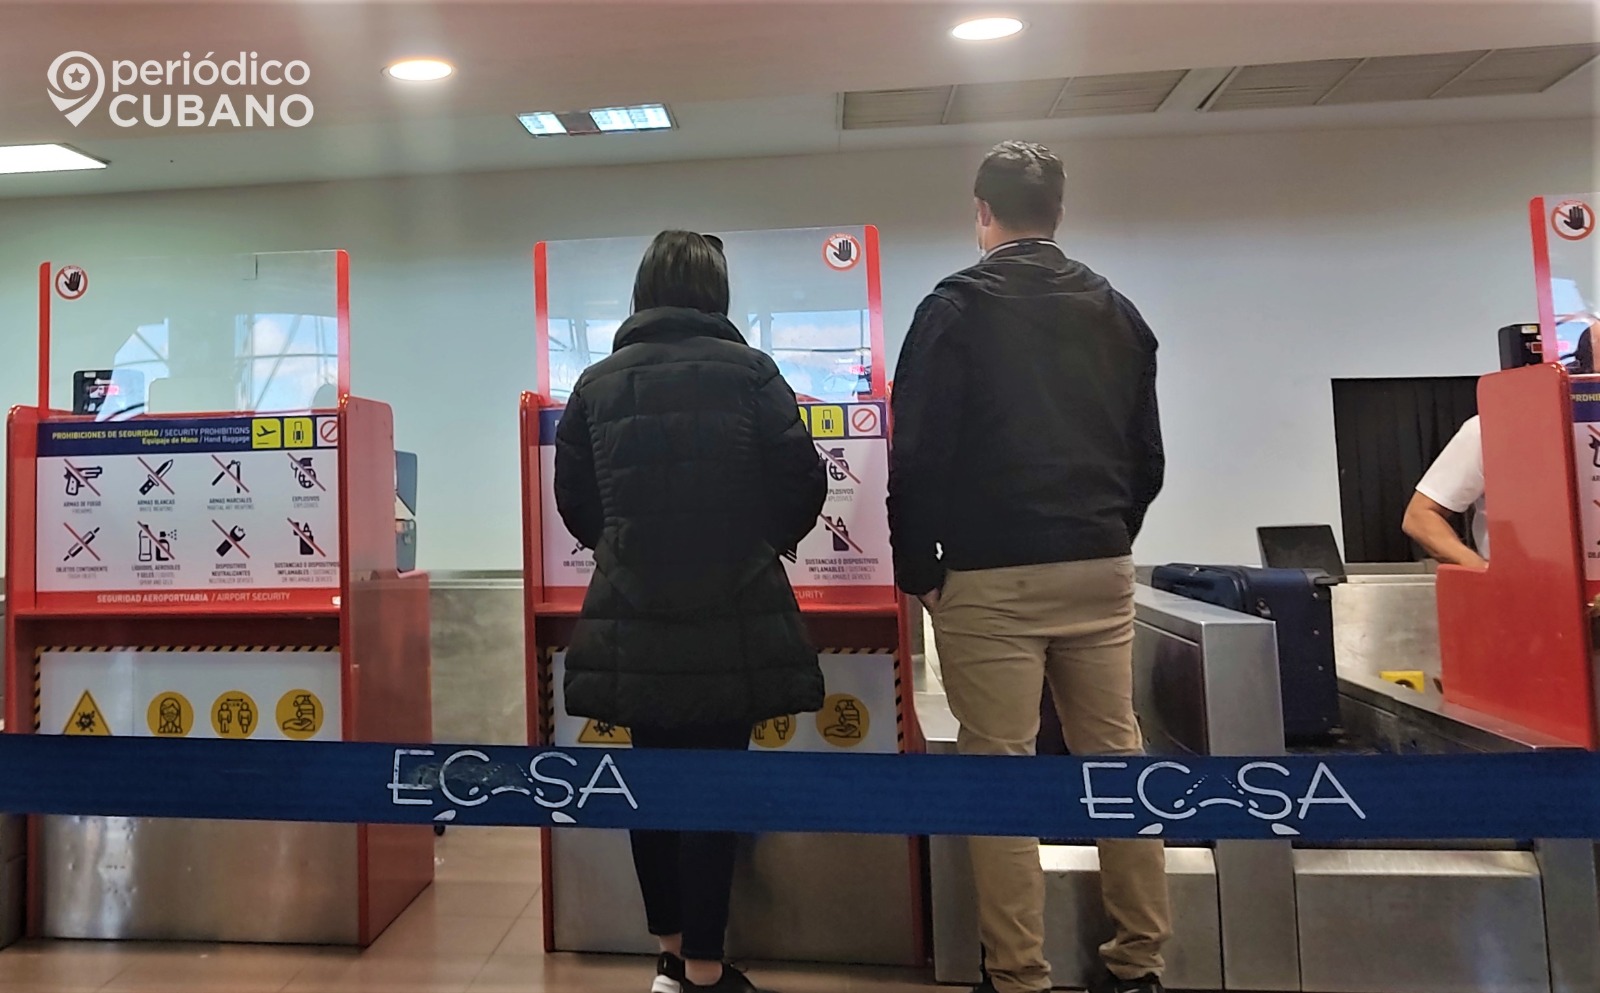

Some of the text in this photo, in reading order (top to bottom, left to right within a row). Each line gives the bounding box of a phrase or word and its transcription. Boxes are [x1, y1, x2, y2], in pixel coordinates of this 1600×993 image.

[52, 431, 106, 439] PROHIBICIONES
[107, 430, 116, 438] DE
[118, 430, 159, 438] SEGURIDAD
[164, 428, 198, 437] SECURITY
[200, 427, 250, 435] PROHIBITIONS
[142, 437, 170, 445] Equipaje
[222, 436, 250, 444] Baggage
[97, 594, 141, 603] SEGURIDAD
[142, 593, 209, 603] AEROPORTUARIA
[217, 592, 250, 601] AIRPORT
[252, 592, 290, 601] SECURITY
[795, 590, 824, 599] CURITY
